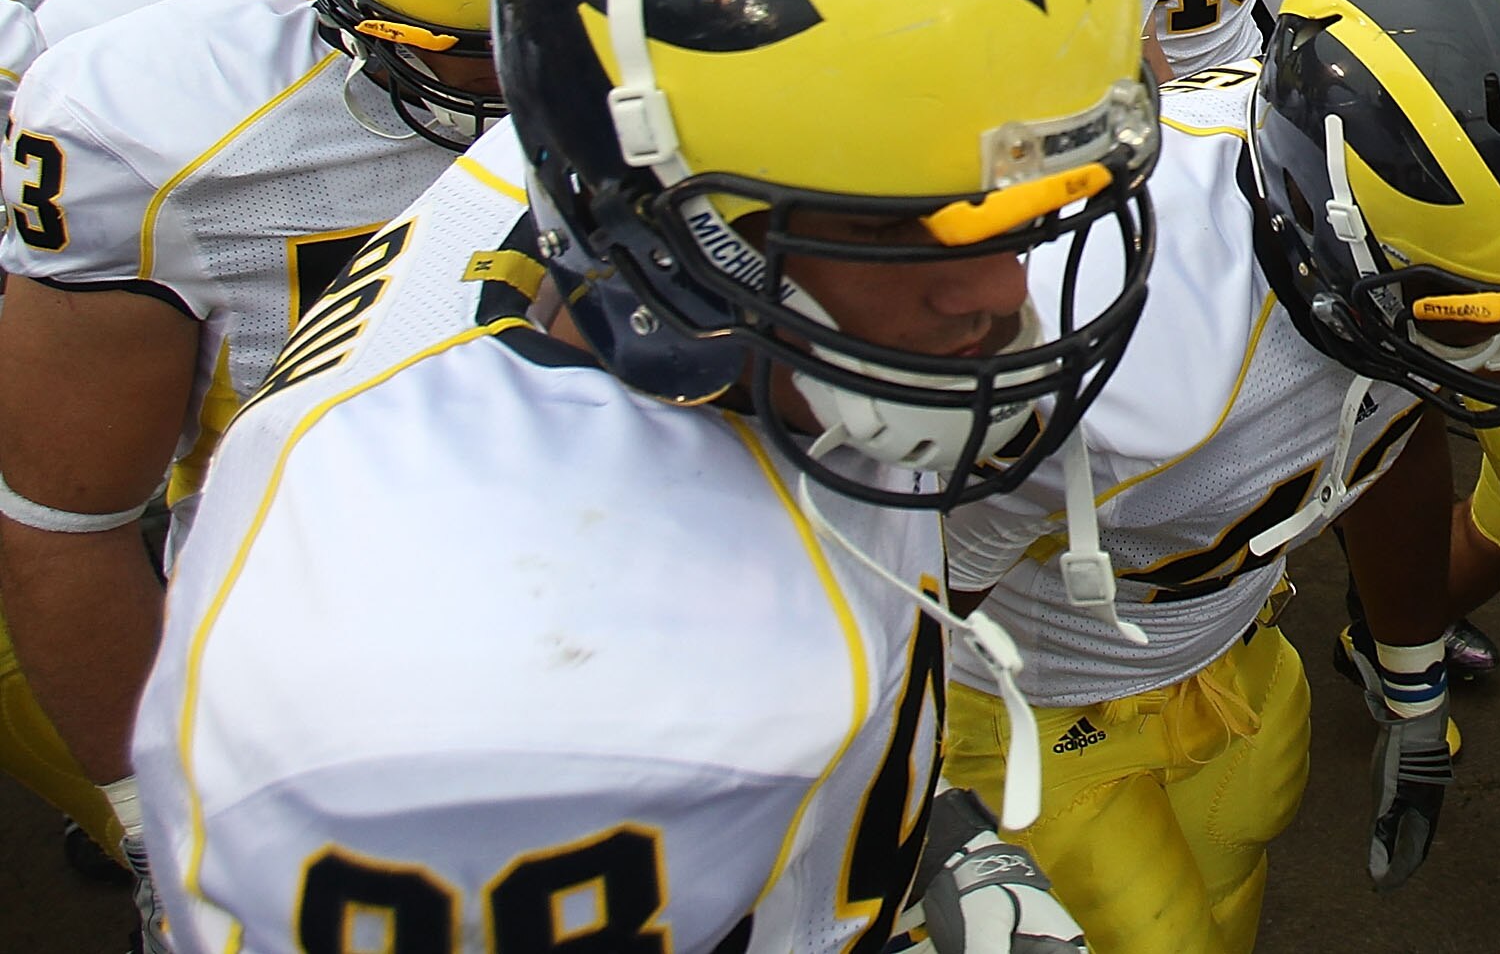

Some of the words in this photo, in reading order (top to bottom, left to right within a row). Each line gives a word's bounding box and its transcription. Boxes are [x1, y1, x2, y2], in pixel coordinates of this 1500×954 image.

[4, 112, 71, 253] 3
[688, 211, 797, 303] MICHIN
[1053, 730, 1107, 754] adidas
